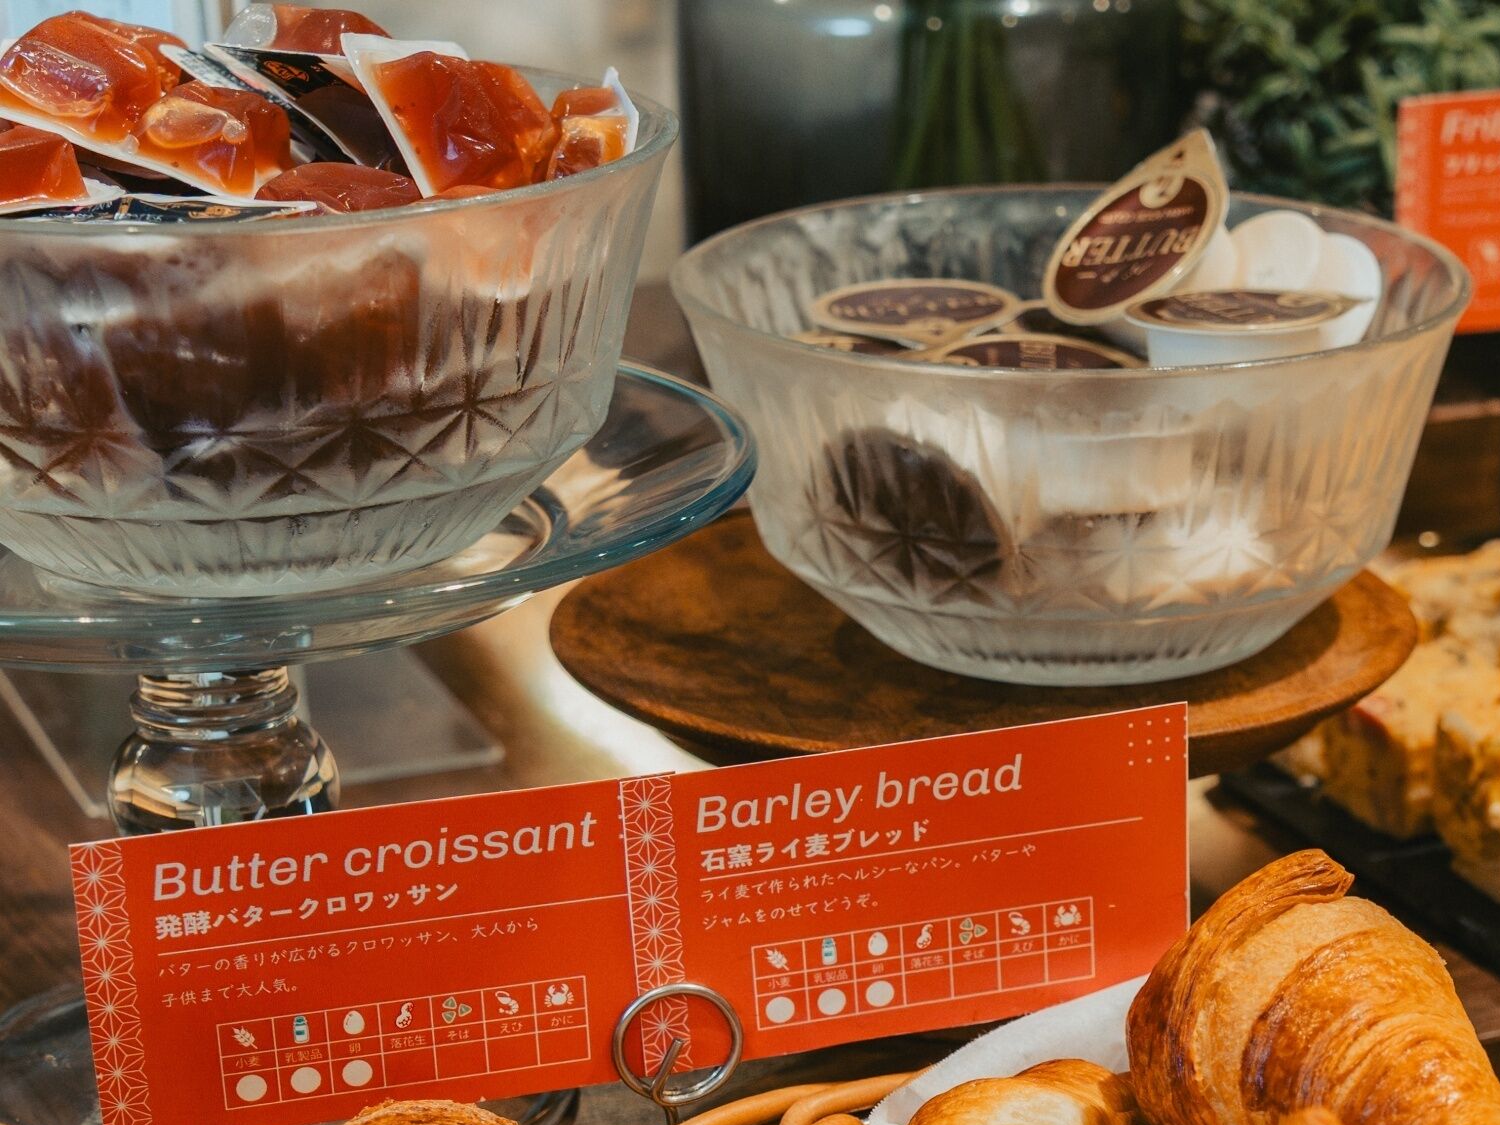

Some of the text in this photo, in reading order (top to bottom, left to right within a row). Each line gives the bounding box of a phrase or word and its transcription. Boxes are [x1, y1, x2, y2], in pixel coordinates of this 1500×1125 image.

[1061, 223, 1202, 267] BUTTER
[696, 753, 1022, 833] Barley bread
[153, 811, 597, 901] Butter croissant
[701, 818, 930, 872] 石窯ライ麦ブレッド
[155, 882, 458, 940] 発酵バタークロワッサン
[702, 893, 879, 931] ジャムをのせてどうぞ。
[161, 977, 298, 1008] 子供まで大人気。
[768, 977, 791, 990] 小麦
[813, 970, 849, 984] 乳製品
[910, 955, 944, 970] 落花生
[235, 1056, 262, 1069] 小麦
[285, 1049, 323, 1063] 乳製品
[349, 1042, 362, 1054] 卵
[390, 1034, 427, 1049] 落花生
[447, 1029, 470, 1041] そば
[551, 1015, 574, 1027] かに
